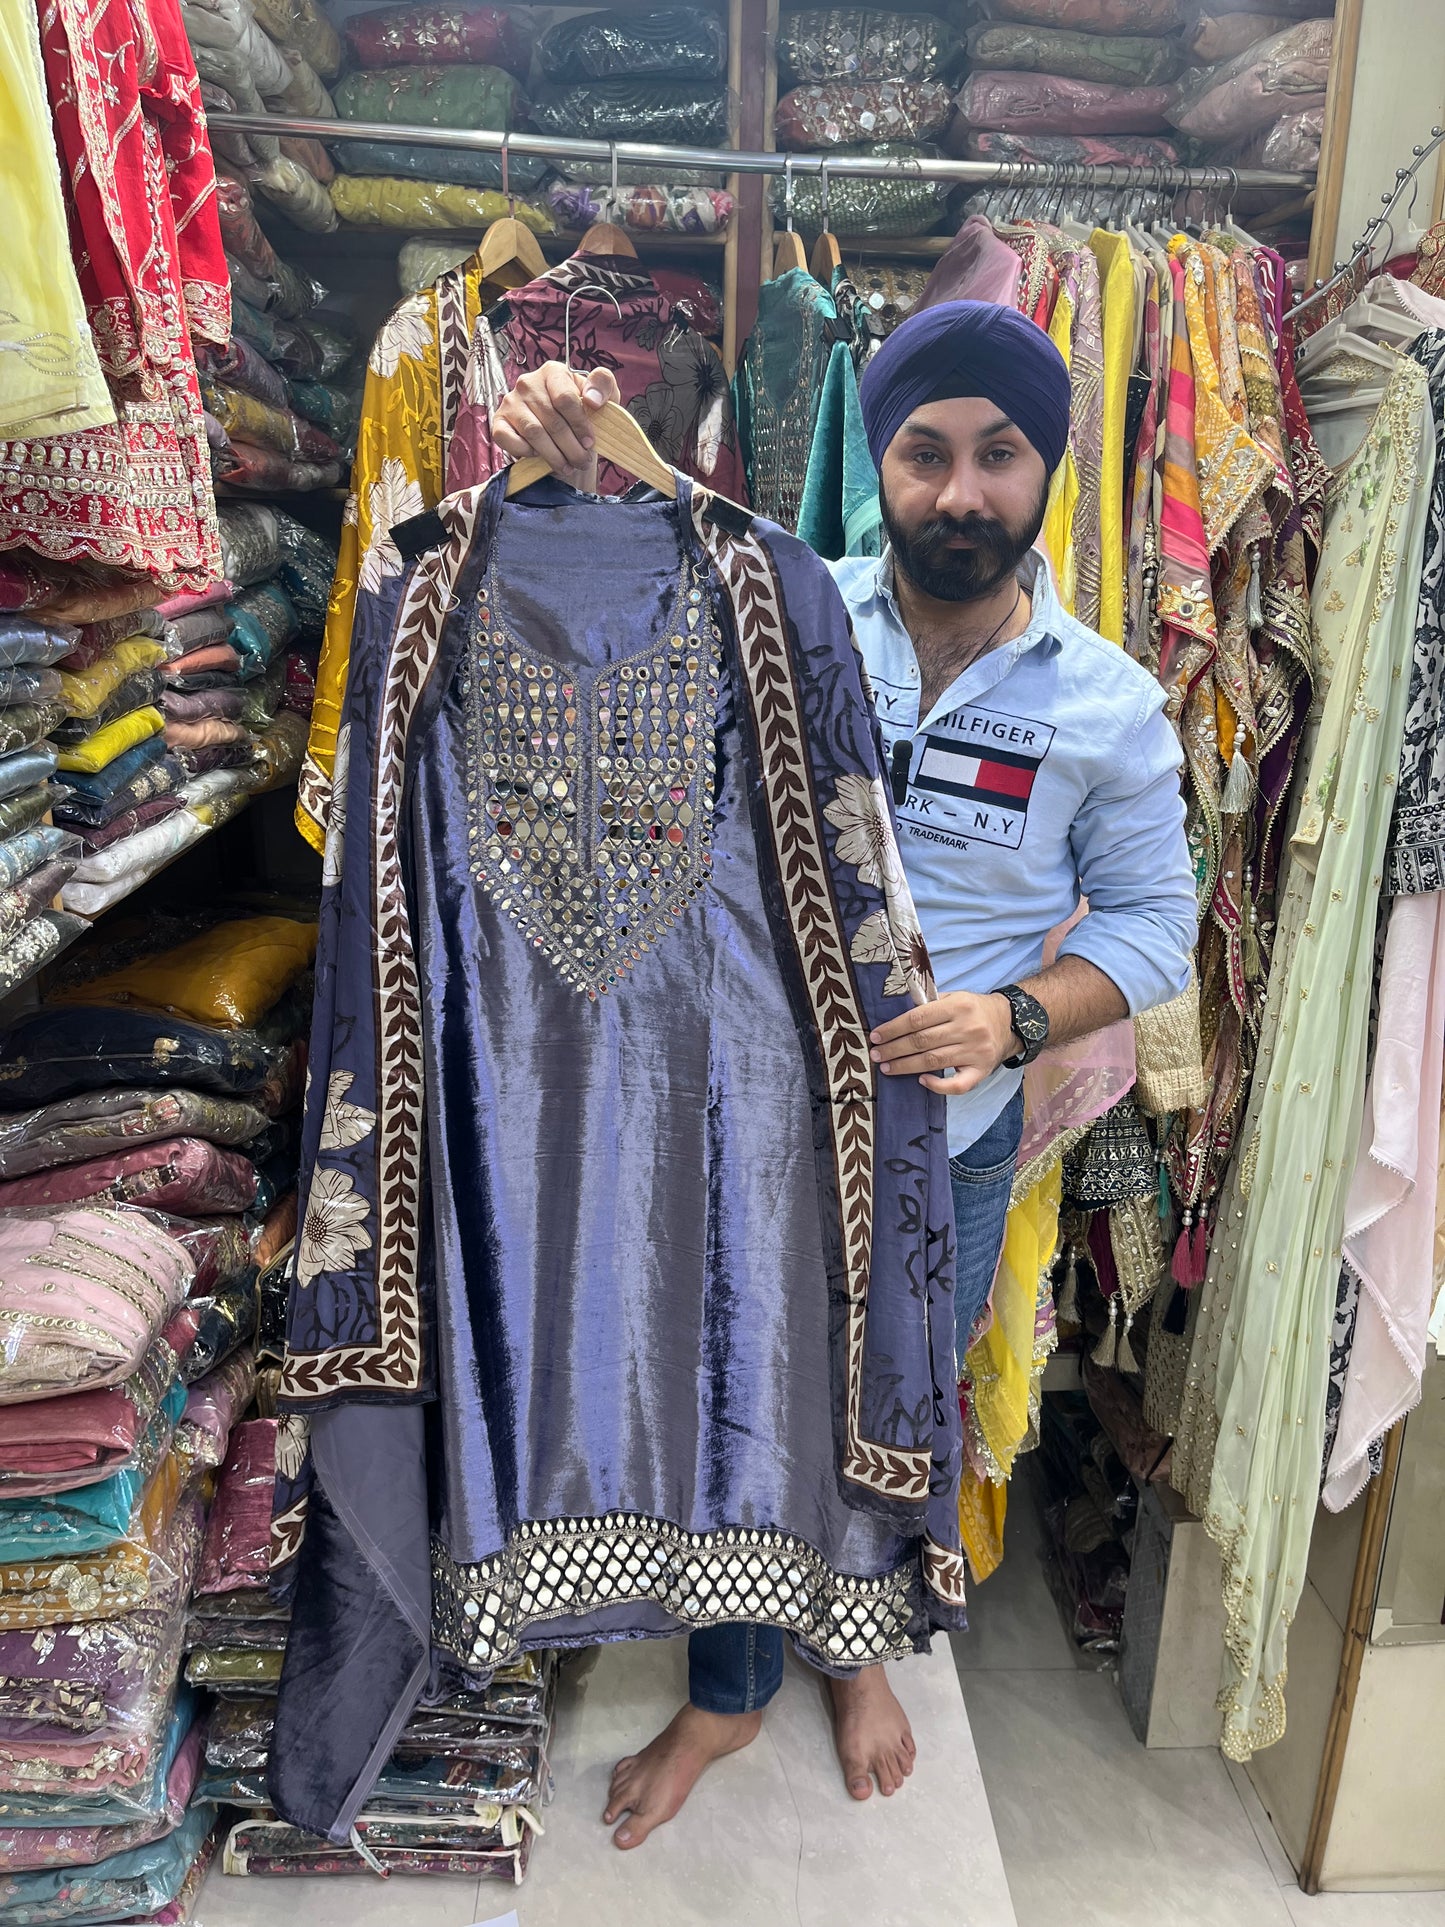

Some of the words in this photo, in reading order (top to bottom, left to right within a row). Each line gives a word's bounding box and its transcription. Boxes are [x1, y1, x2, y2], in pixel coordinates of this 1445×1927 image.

[935, 712, 1036, 746] HILFIGER
[973, 811, 1014, 834] N.Y
[908, 826, 969, 851] TRADEMARK
